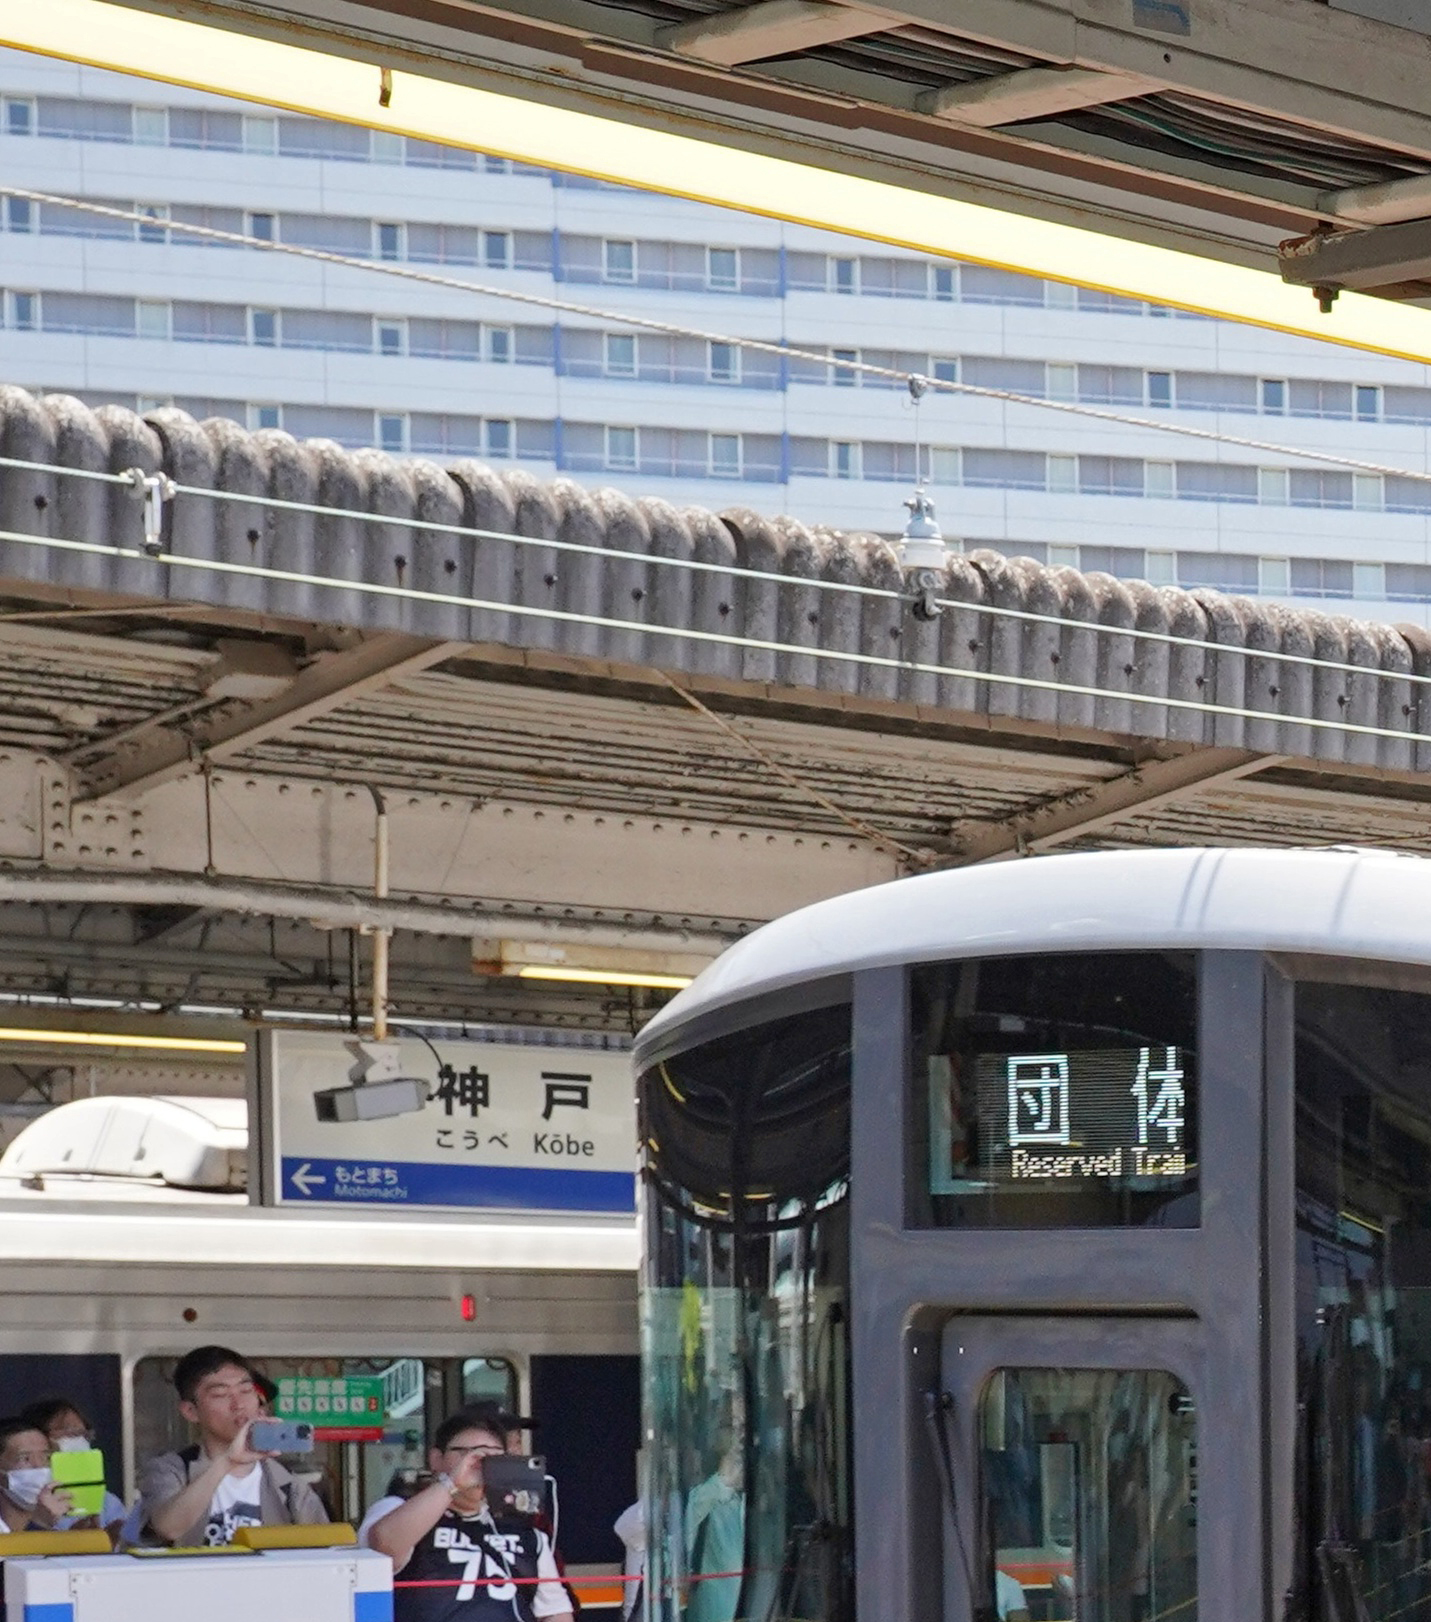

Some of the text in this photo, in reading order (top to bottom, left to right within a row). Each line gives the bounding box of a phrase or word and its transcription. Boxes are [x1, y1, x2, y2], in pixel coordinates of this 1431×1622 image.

[439, 1063, 592, 1121] 神戸
[436, 1130, 595, 1157] こうべ Kōbe
[1012, 1147, 1122, 1178] Reserved
[447, 1549, 518, 1601] 75
